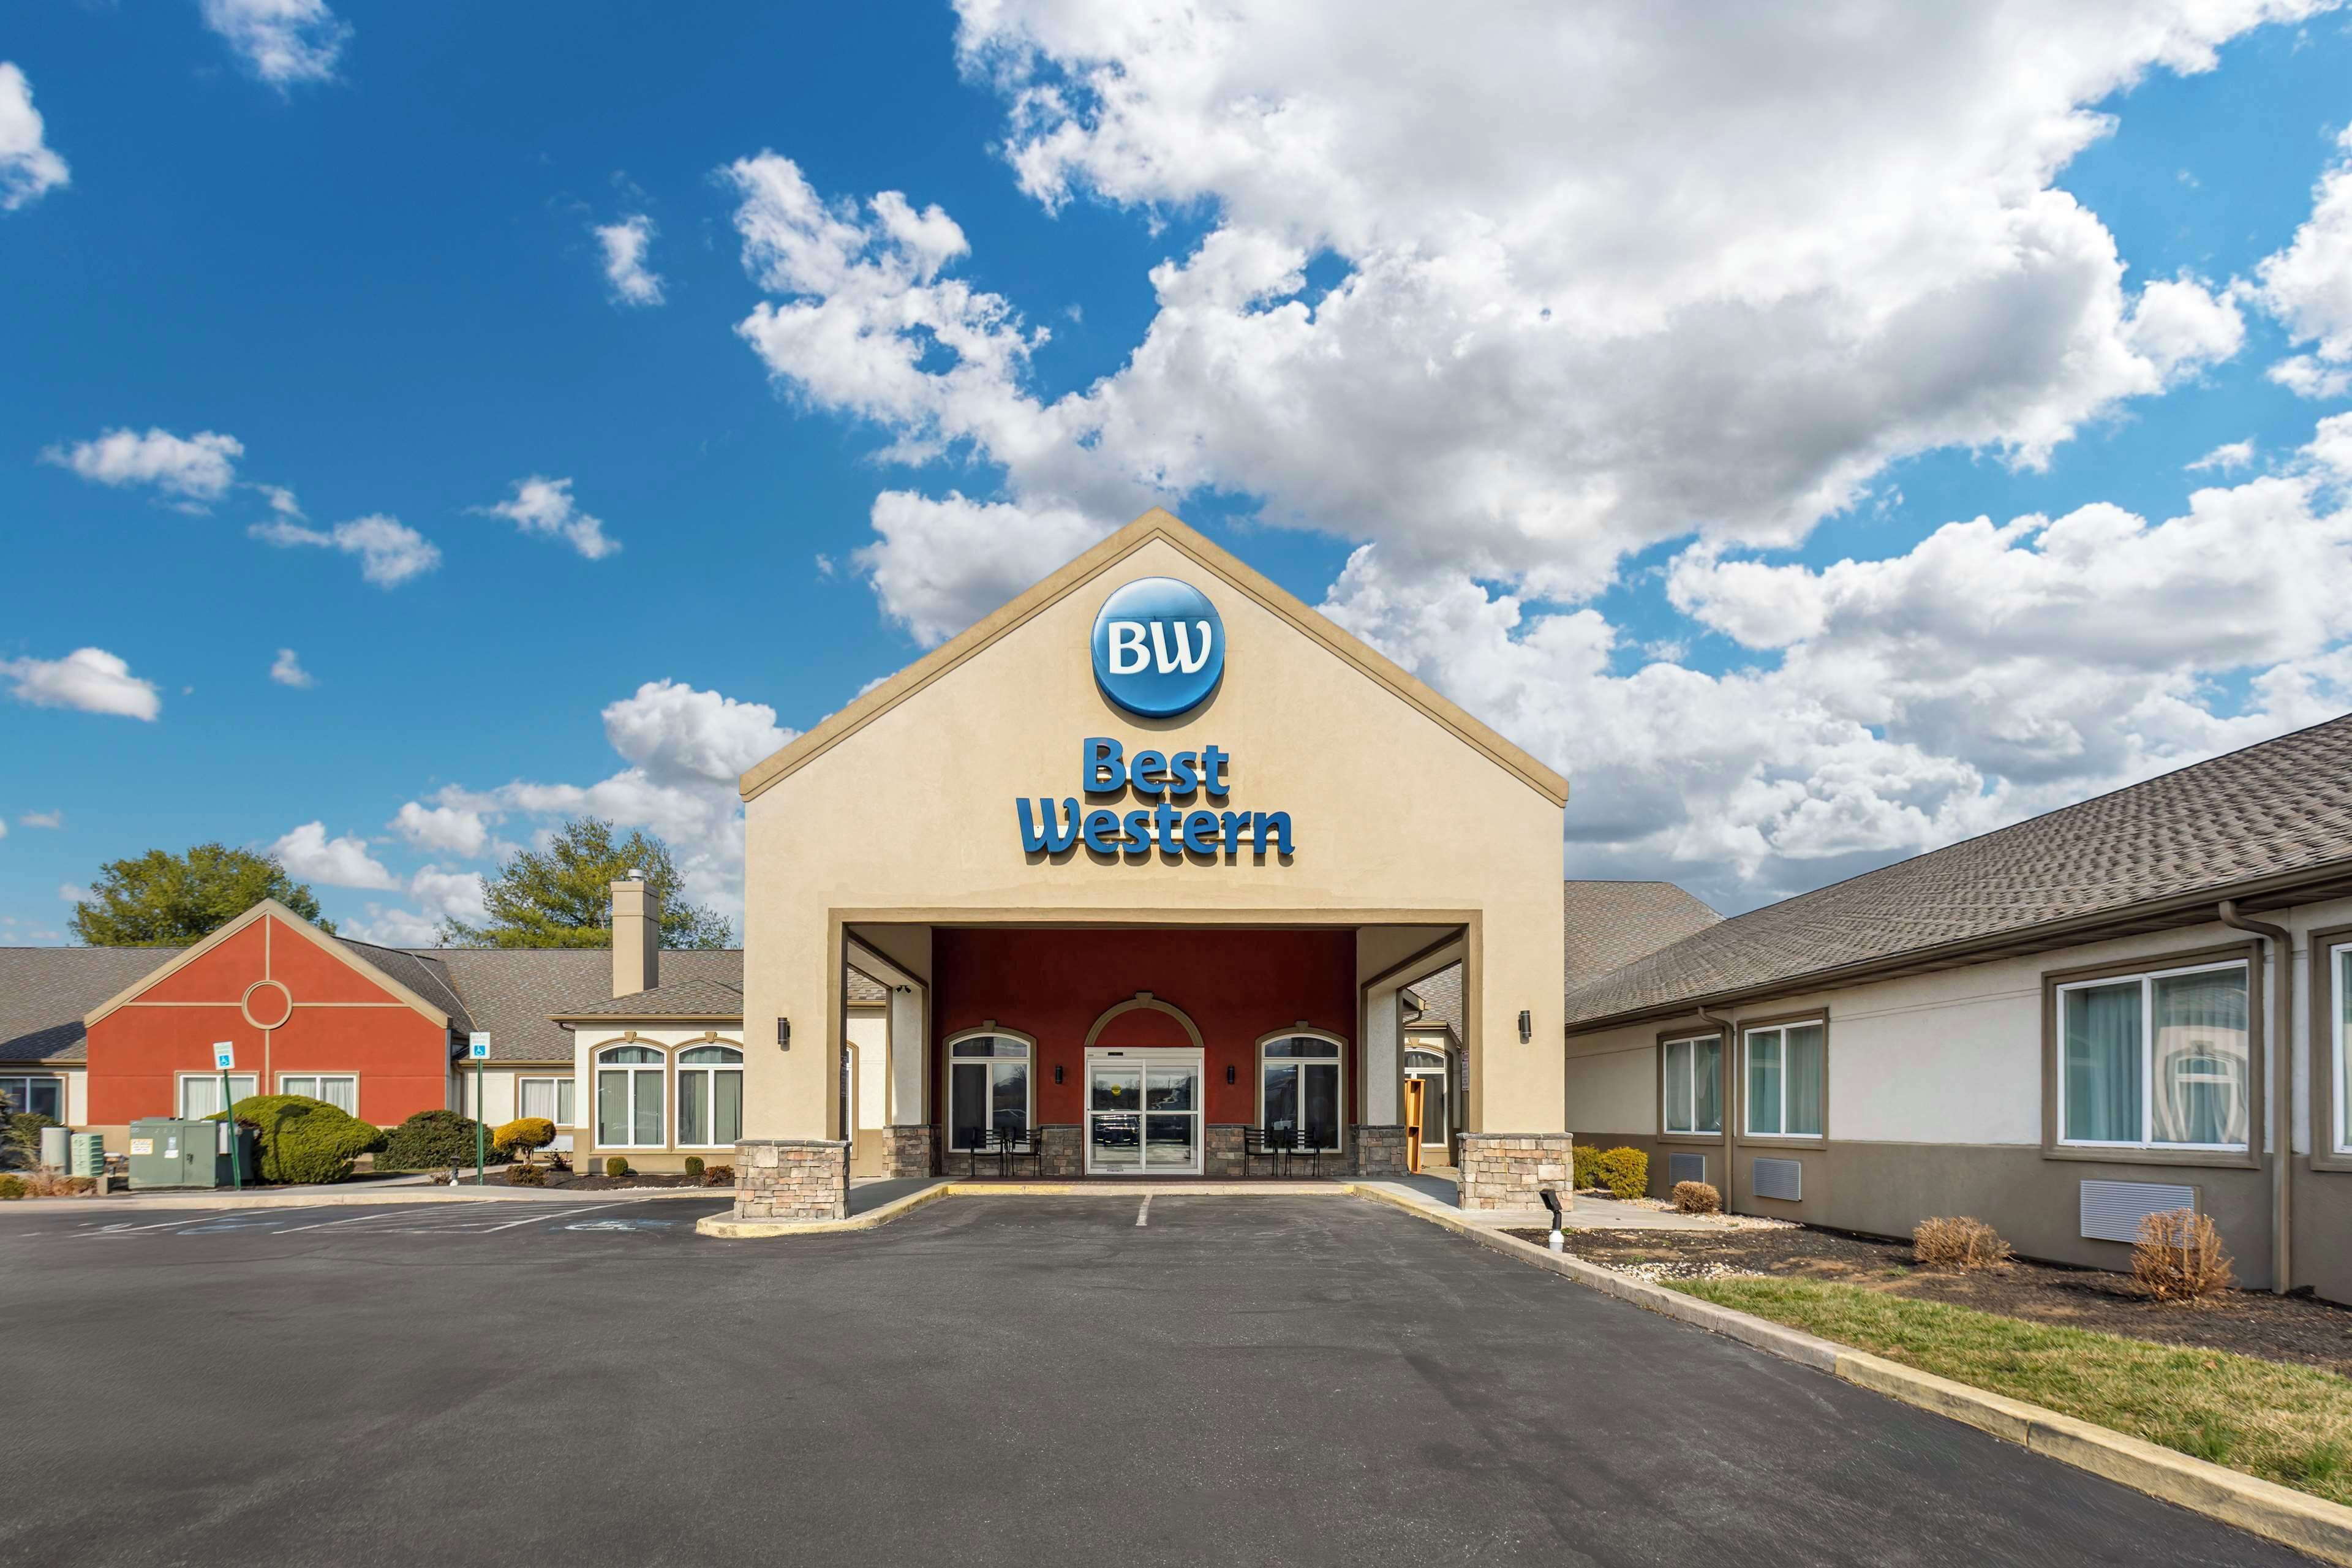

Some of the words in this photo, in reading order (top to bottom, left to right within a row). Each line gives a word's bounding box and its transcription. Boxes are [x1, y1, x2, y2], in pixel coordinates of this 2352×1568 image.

[1108, 620, 1212, 674] BW
[1083, 737, 1230, 796] Best
[1016, 797, 1296, 854] Western
